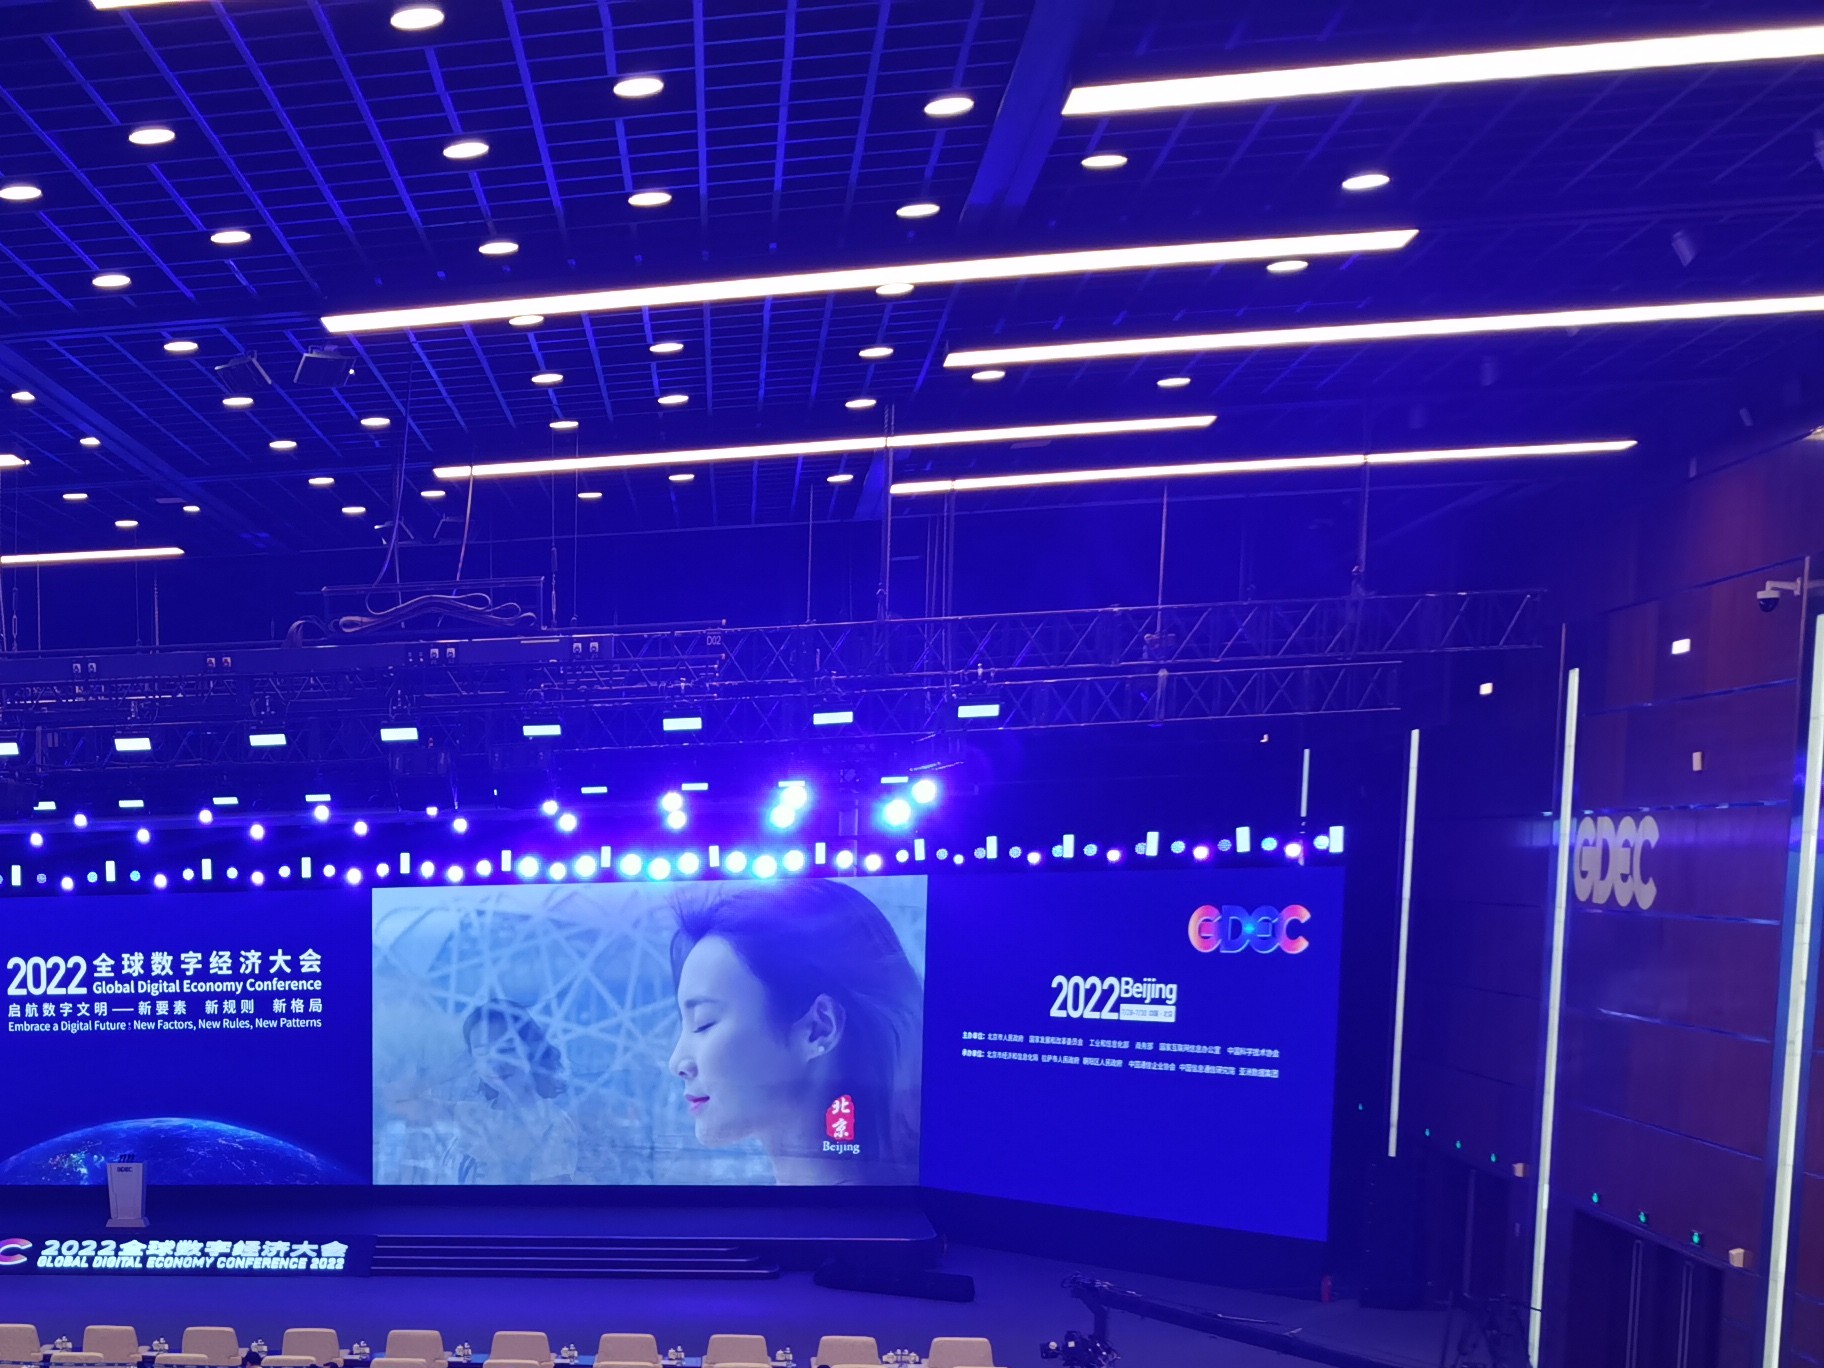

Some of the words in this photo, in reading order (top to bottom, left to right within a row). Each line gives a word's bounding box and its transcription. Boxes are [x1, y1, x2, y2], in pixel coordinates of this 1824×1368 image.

[1574, 815, 1660, 910] GDEC
[1188, 904, 1311, 954] GDEC
[7, 956, 87, 995] 2022
[92, 948, 322, 977] 全球数字经济大会
[92, 980, 135, 994] Global
[137, 979, 180, 997] Digital
[183, 979, 243, 995] Economy
[246, 977, 322, 991] Conference
[205, 999, 255, 1014] 新规则
[272, 998, 323, 1014] 新格局
[1049, 974, 1120, 1020] 2022
[1120, 977, 1177, 1004] Beijing
[8, 1020, 51, 1032] Embrace
[52, 1022, 59, 1031] a
[60, 1020, 92, 1034] Digital
[133, 1019, 155, 1030] New
[157, 1019, 197, 1031] Factors,
[198, 1018, 221, 1029] New
[223, 1018, 254, 1030] Rules,
[255, 1017, 277, 1028] New
[280, 1017, 322, 1028] Patterns
[831, 1096, 851, 1138] 北京
[822, 1140, 860, 1154] Beijing
[37, 1255, 89, 1268] GLOBAL
[92, 1255, 143, 1269] DIGITAL
[146, 1256, 214, 1269] ECONOMY
[216, 1257, 308, 1270] CONFERENCE
[310, 1257, 345, 1270] 2022
